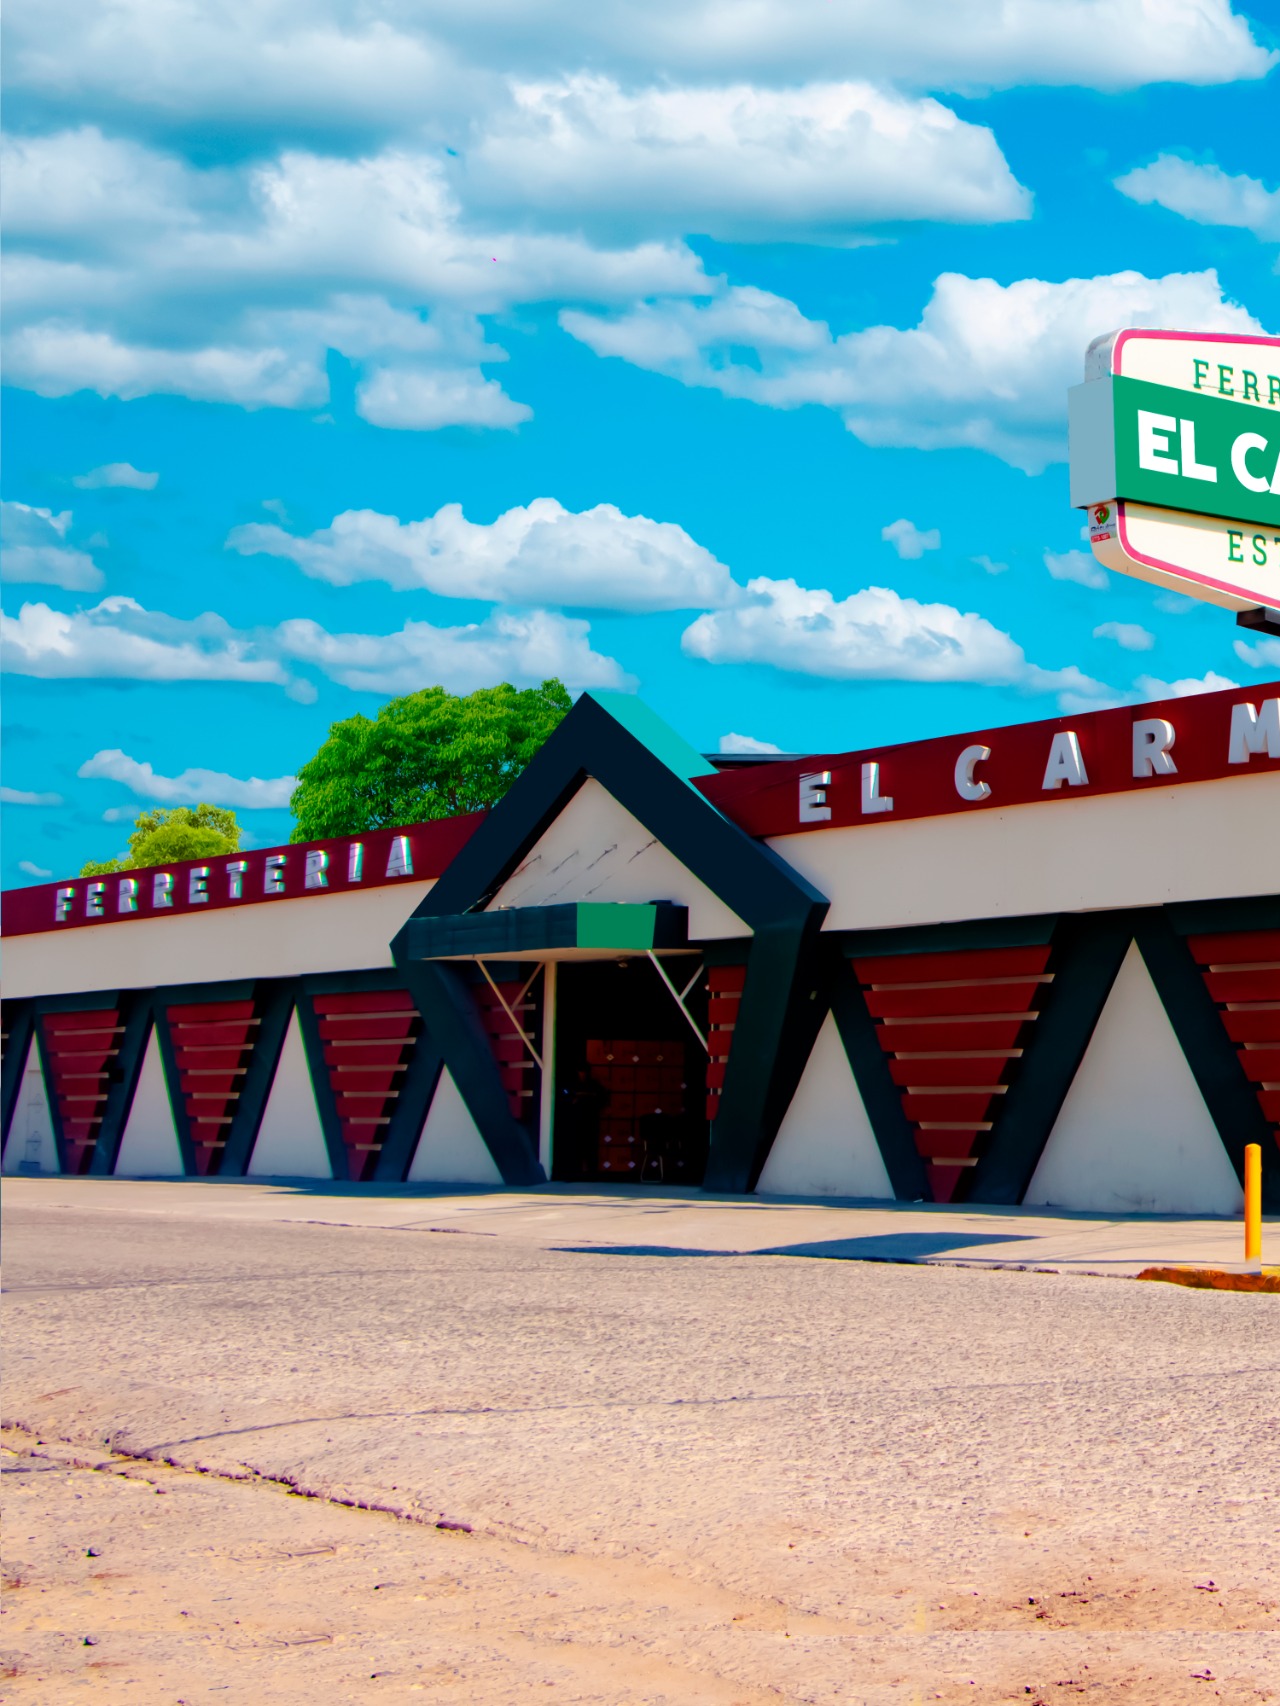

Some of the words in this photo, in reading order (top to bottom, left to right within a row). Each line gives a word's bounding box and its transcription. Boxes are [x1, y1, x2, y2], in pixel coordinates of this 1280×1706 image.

[1137, 410, 1218, 483] EL
[800, 762, 893, 823] EL
[55, 835, 414, 922] FERRETERIA
